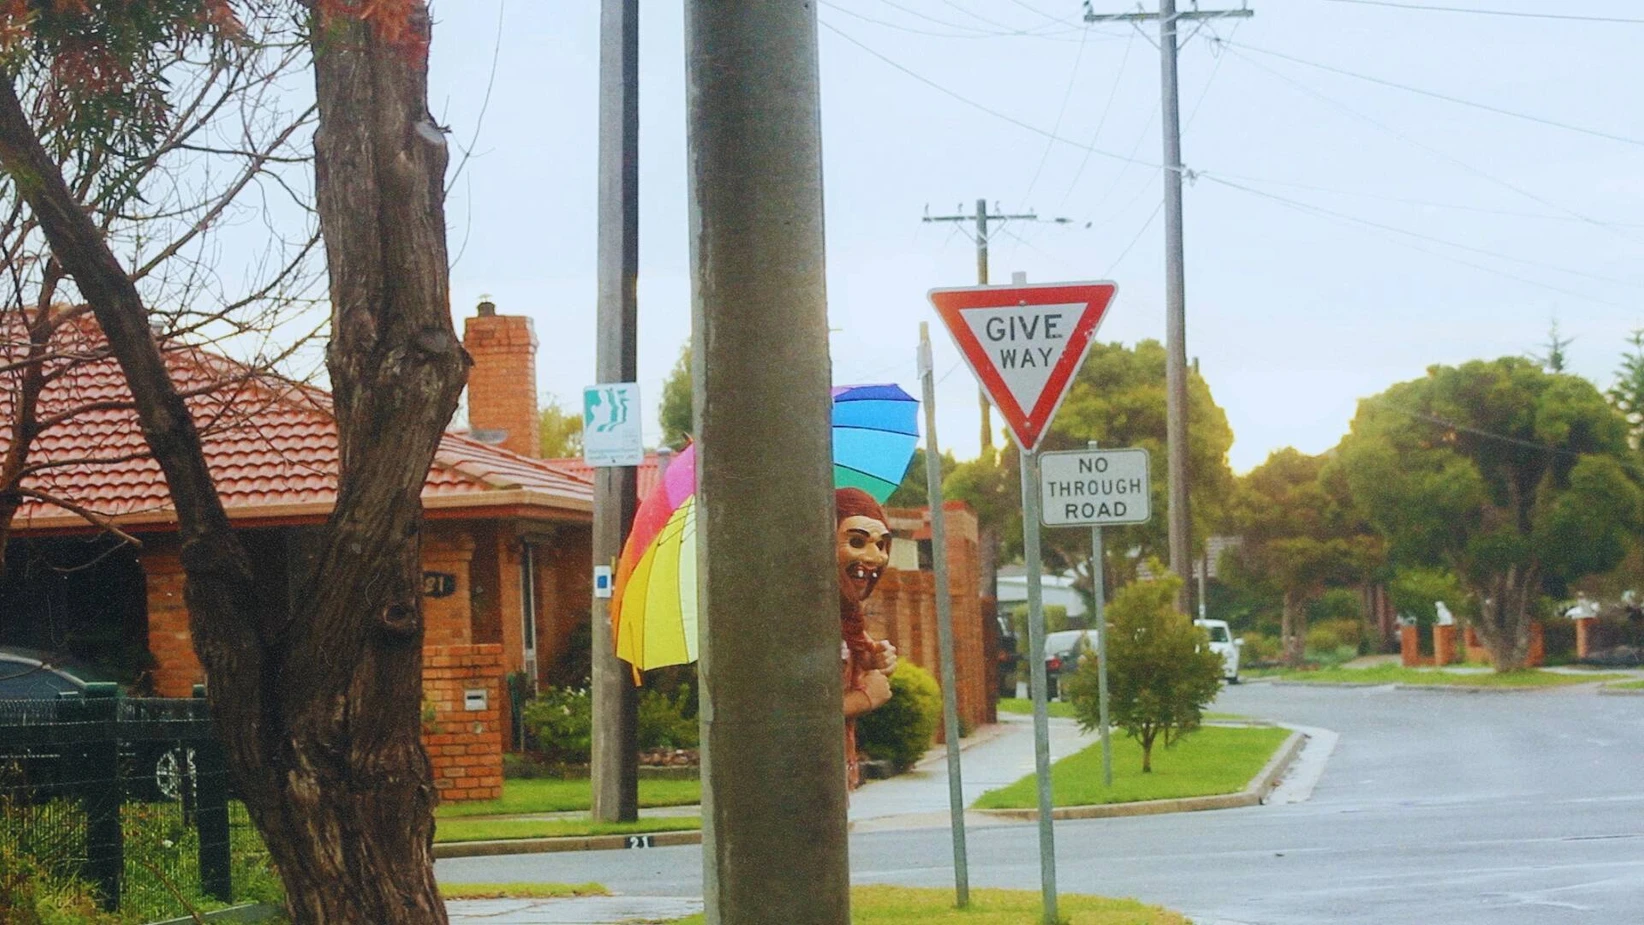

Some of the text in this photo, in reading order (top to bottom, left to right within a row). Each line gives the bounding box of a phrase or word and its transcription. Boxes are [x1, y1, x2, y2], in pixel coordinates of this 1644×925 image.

[986, 314, 1062, 341] GIVE
[1000, 348, 1053, 369] WAY
[1078, 457, 1109, 473] NO
[1048, 478, 1142, 497] THROUGH
[1065, 501, 1127, 519] ROAD
[630, 836, 649, 849] 21
